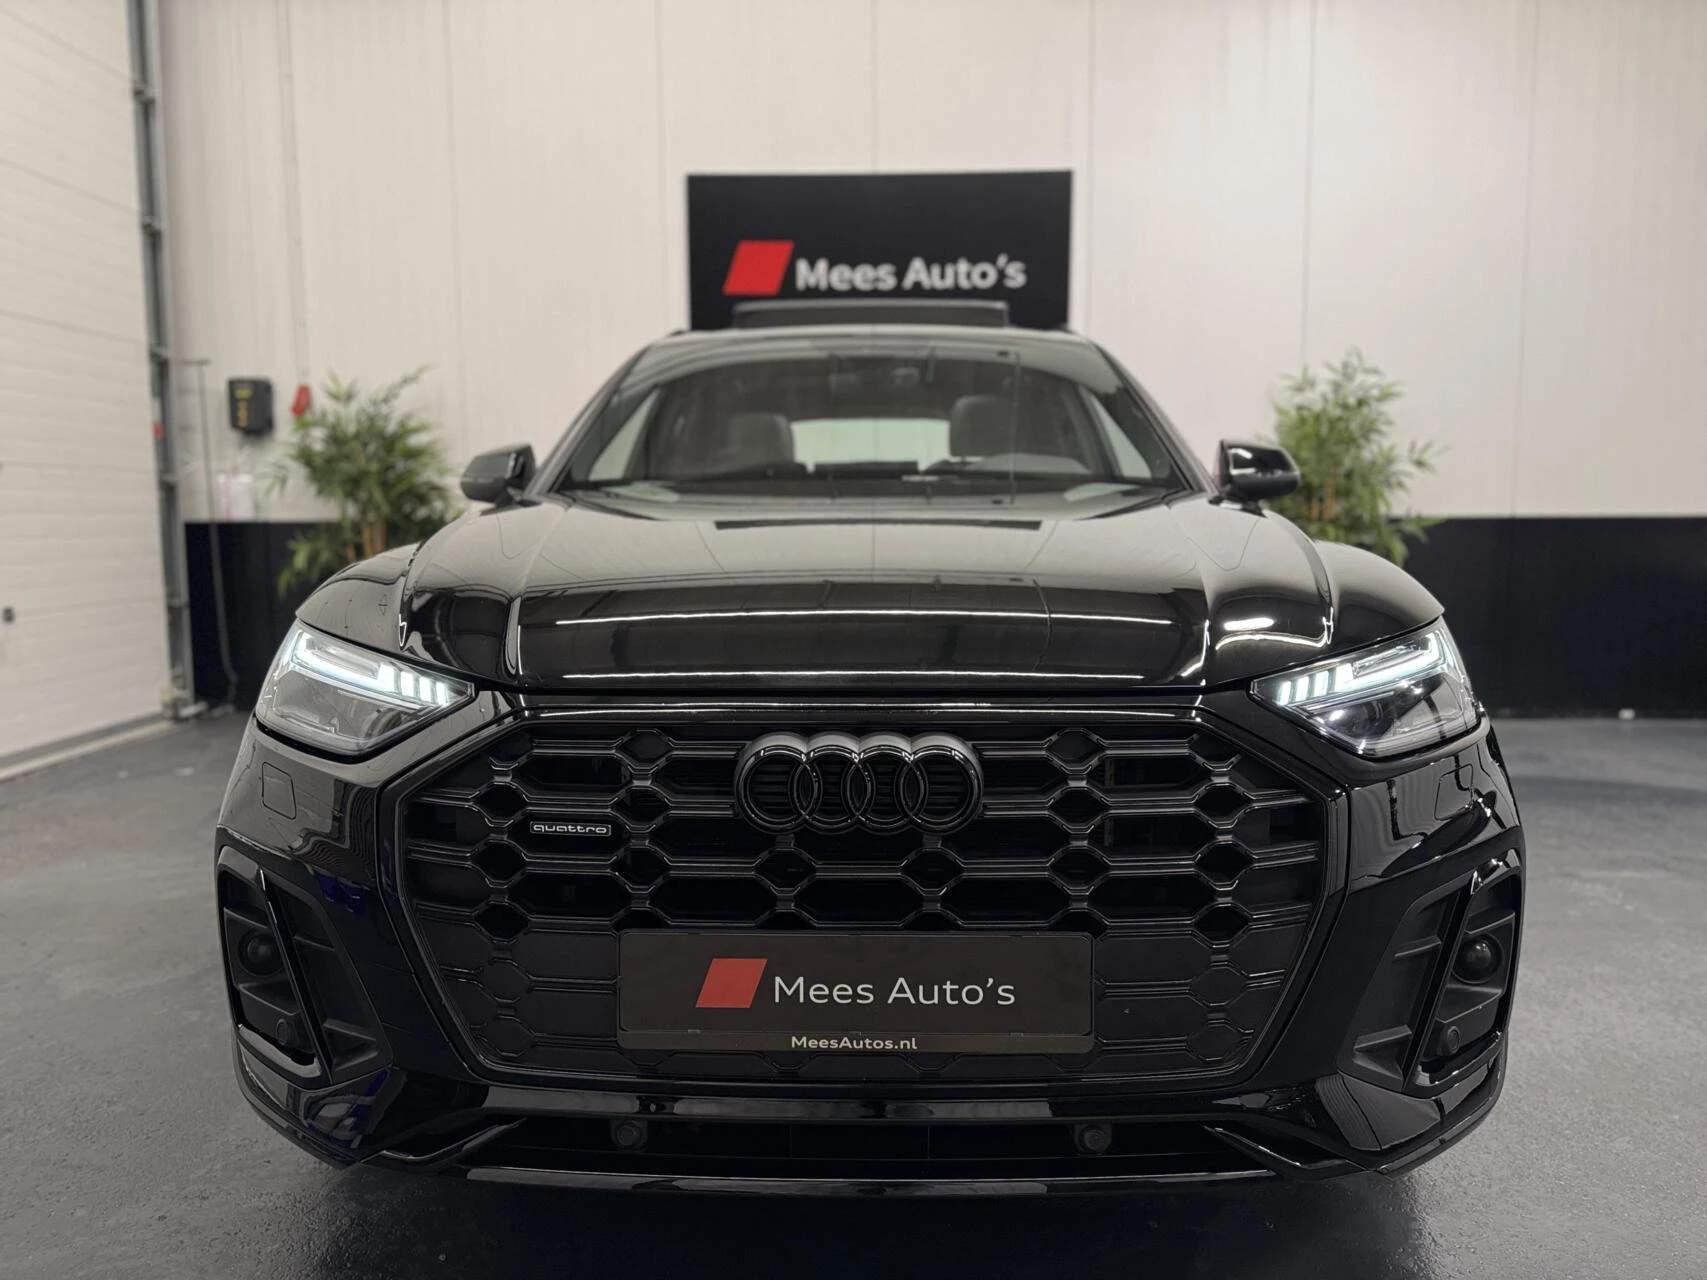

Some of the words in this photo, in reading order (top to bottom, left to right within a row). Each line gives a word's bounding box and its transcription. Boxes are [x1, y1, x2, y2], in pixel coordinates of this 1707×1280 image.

[795, 258, 897, 290] Mees
[902, 254, 1027, 290] Auto's
[533, 823, 607, 834] quattro
[774, 976, 874, 1004] Mees
[887, 977, 1015, 1005] Auto's
[791, 1036, 918, 1050] MeesAutos.nl
